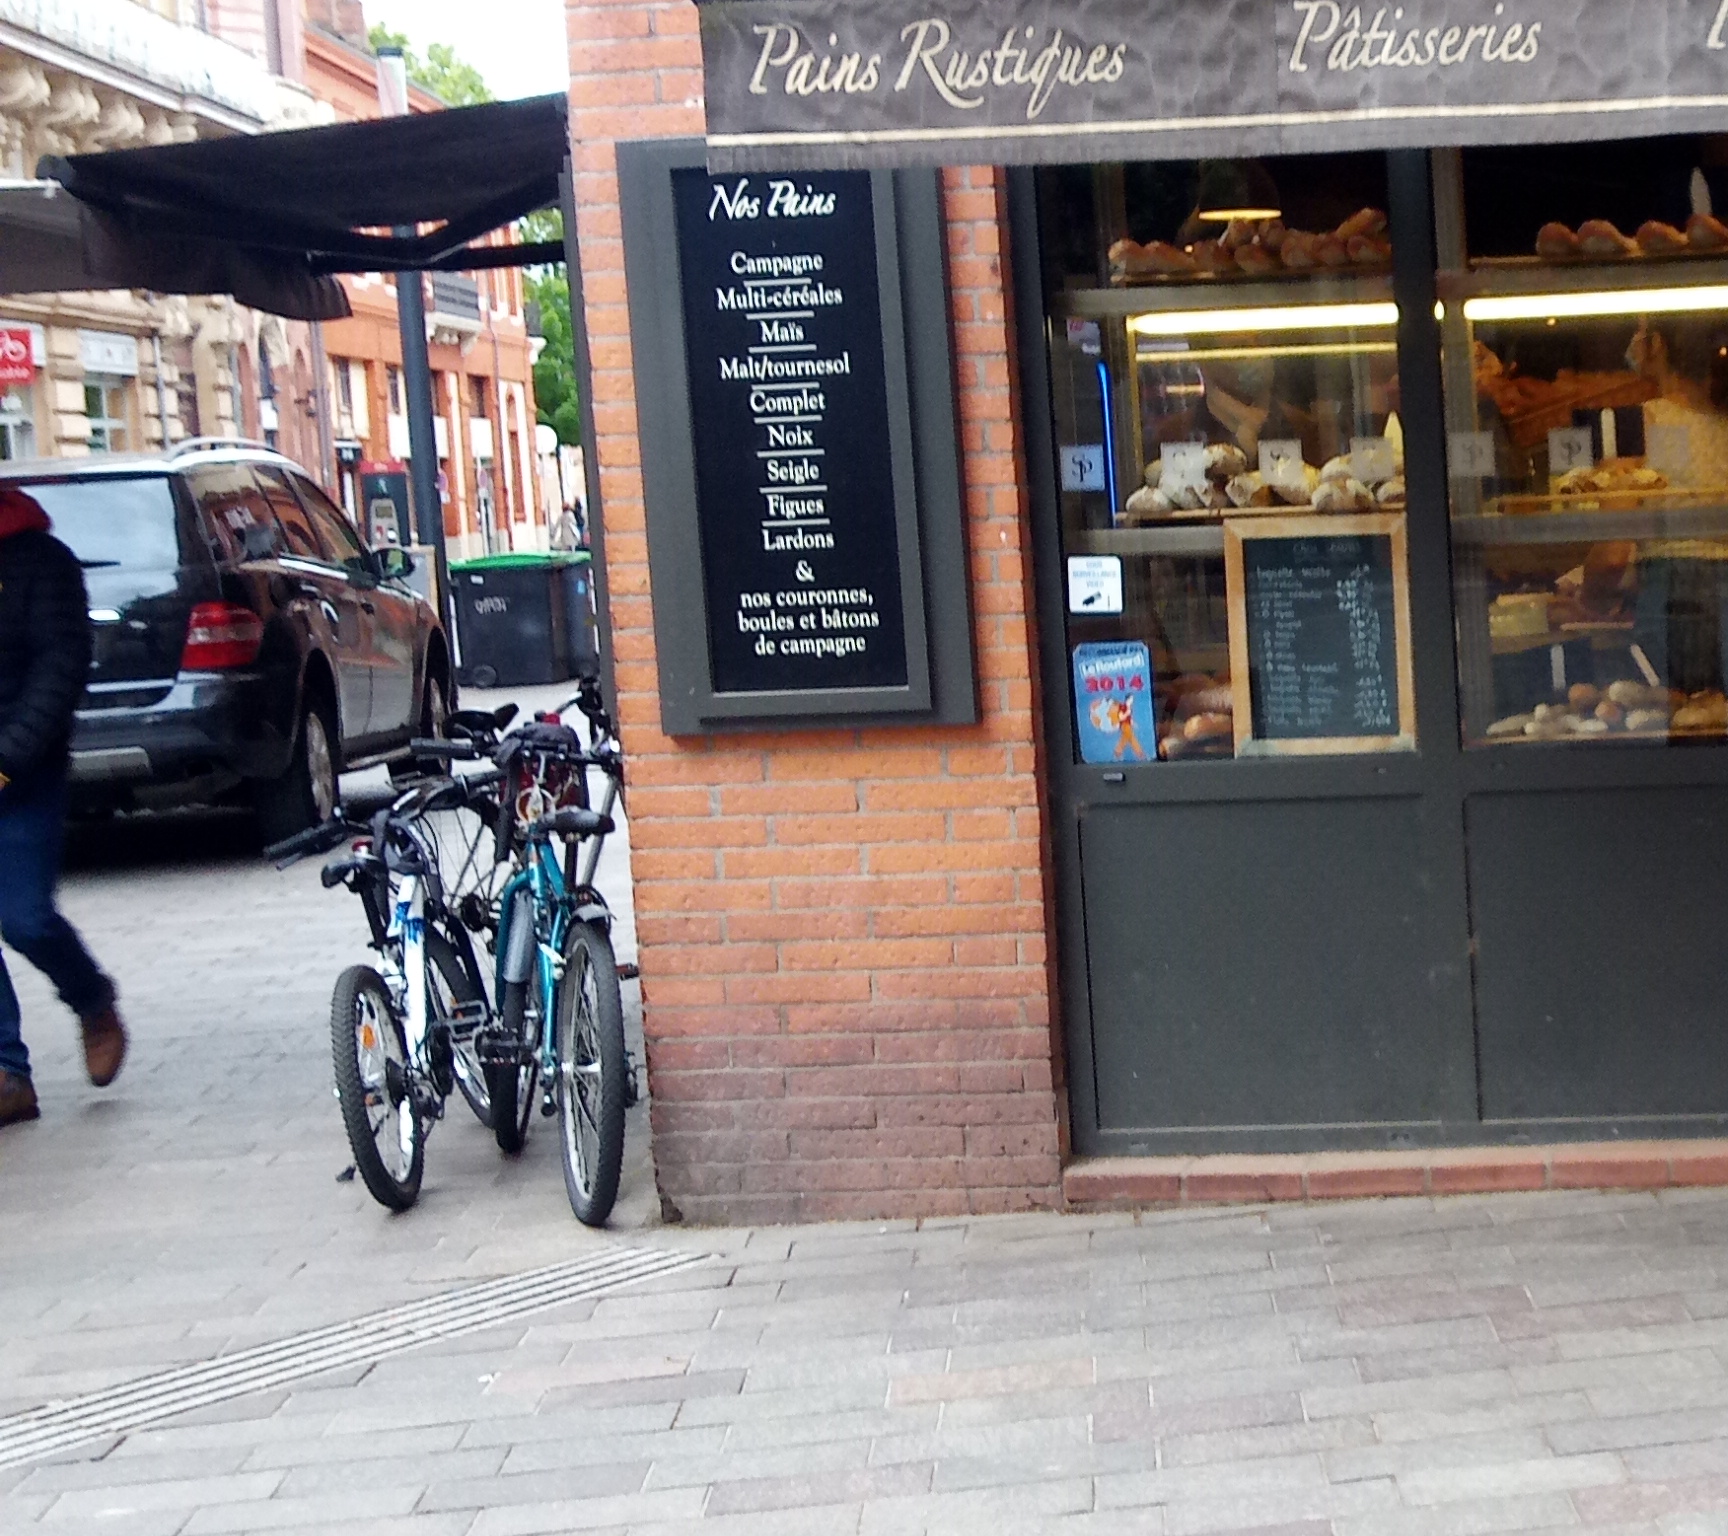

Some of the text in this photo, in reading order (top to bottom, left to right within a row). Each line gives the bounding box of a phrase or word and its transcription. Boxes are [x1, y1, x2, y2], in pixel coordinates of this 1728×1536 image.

[1287, 0, 1543, 74] Pâtisseries
[748, 17, 1127, 119] Pains Rustiques
[708, 177, 837, 221] Nos Pains
[730, 250, 824, 277] Campagne
[715, 281, 843, 311] Multi-céréales
[760, 320, 805, 343] Maïs
[718, 351, 851, 381] Malt/tournesol
[749, 389, 826, 415] Complet
[766, 424, 814, 447] Noix
[766, 459, 820, 484] Seigle
[766, 494, 825, 519] Figues
[761, 527, 835, 551] Lardons
[795, 559, 815, 583] &
[739, 587, 874, 608] nos couronnes,
[737, 607, 880, 632] boules et bâtons
[754, 634, 866, 658] de campagne
[1086, 676, 1144, 694] 2014
